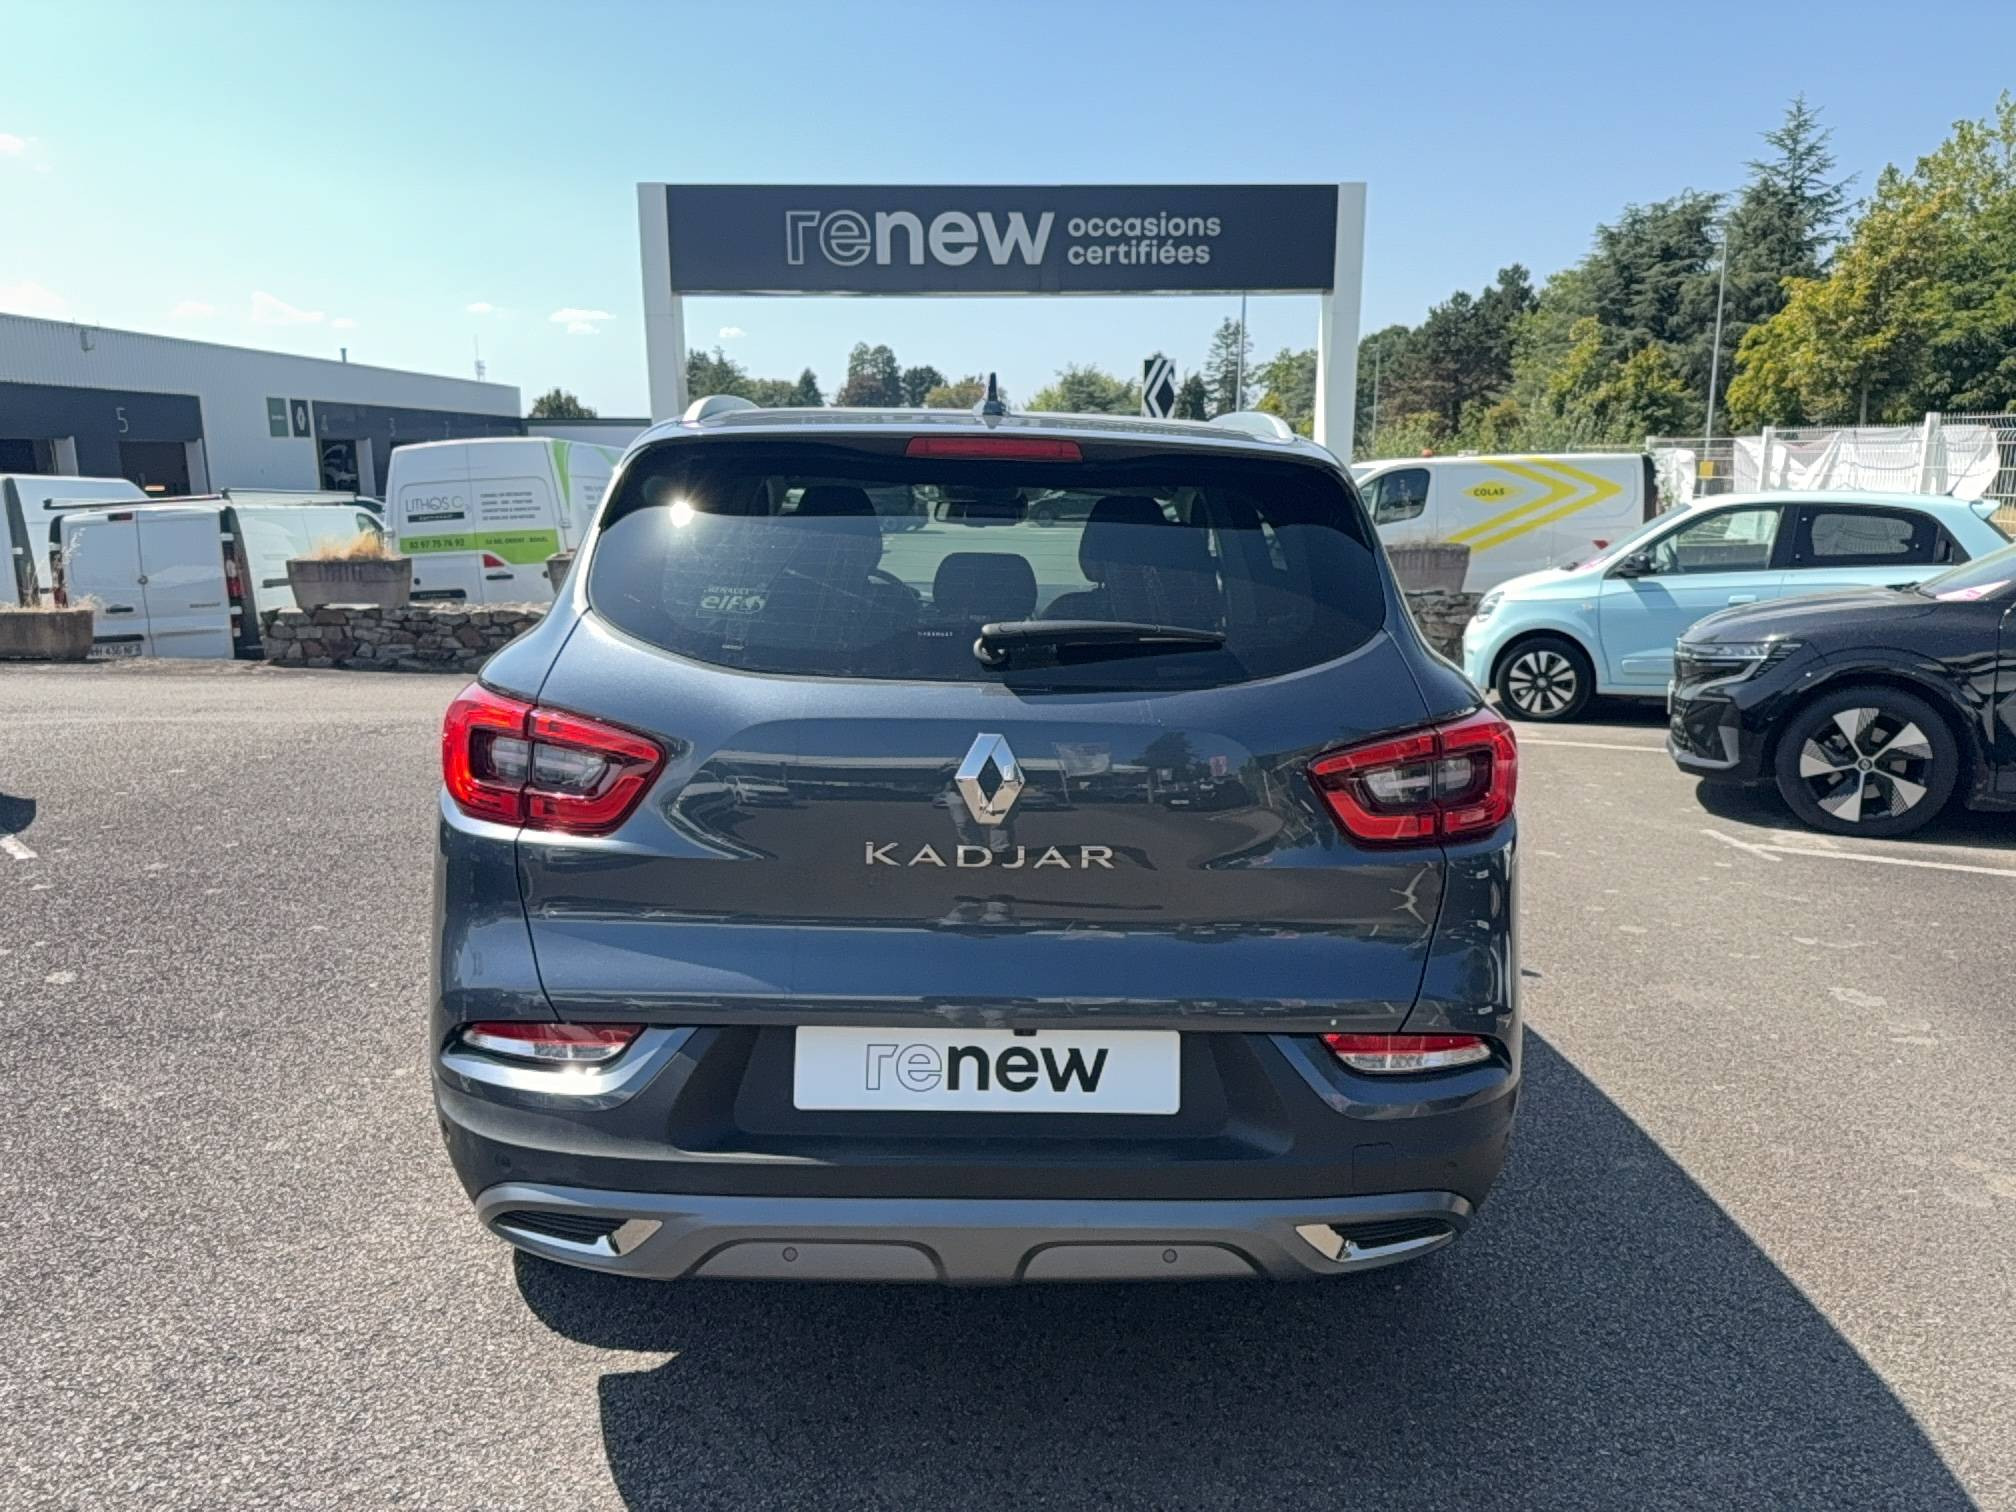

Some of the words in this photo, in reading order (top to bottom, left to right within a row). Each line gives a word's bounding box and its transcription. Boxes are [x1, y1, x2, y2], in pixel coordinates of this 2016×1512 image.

[1067, 211, 1221, 238] occasions
[785, 209, 1055, 267] renew
[1067, 239, 1211, 265] certifiées
[115, 407, 129, 433] 5
[1473, 487, 1505, 497] COLAS
[701, 595, 743, 611] elf
[865, 841, 1115, 869] KADJAR
[866, 1043, 1109, 1093] renew
